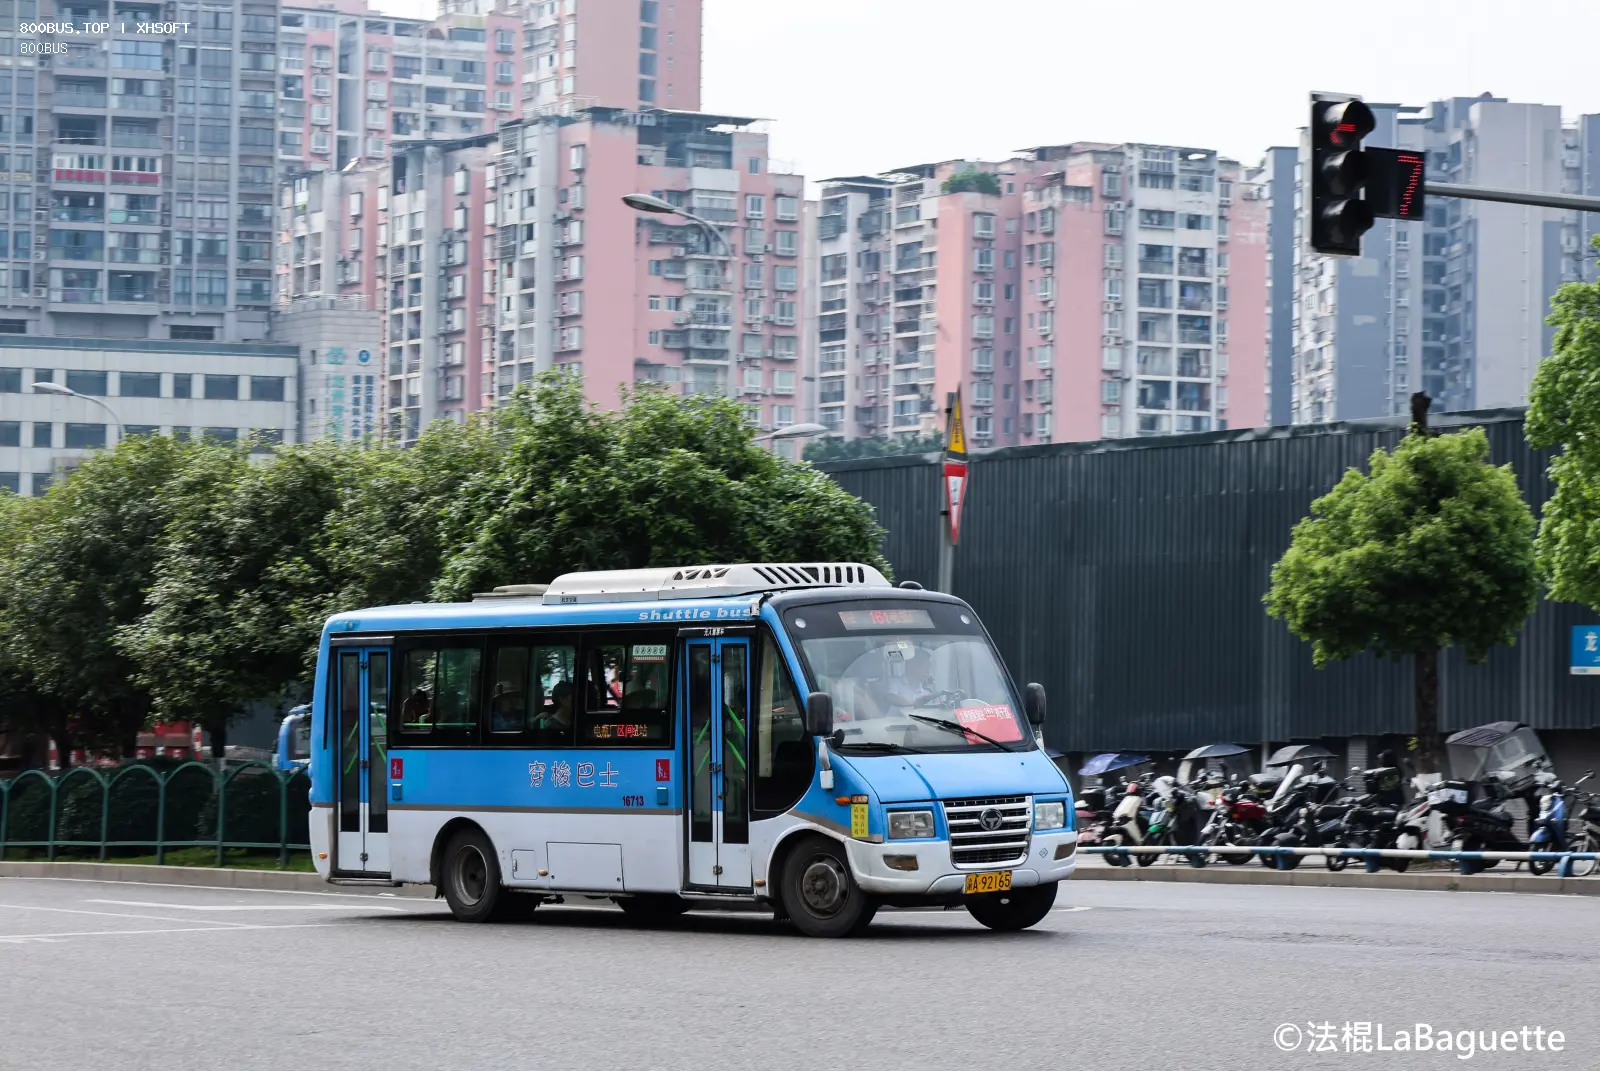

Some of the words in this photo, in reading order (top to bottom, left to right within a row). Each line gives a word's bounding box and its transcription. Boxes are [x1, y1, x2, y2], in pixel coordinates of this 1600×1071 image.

[1397, 155, 1424, 215] 7
[638, 608, 711, 620] shuttle
[528, 760, 619, 788] 穿梭巴士
[622, 795, 645, 807] 16713
